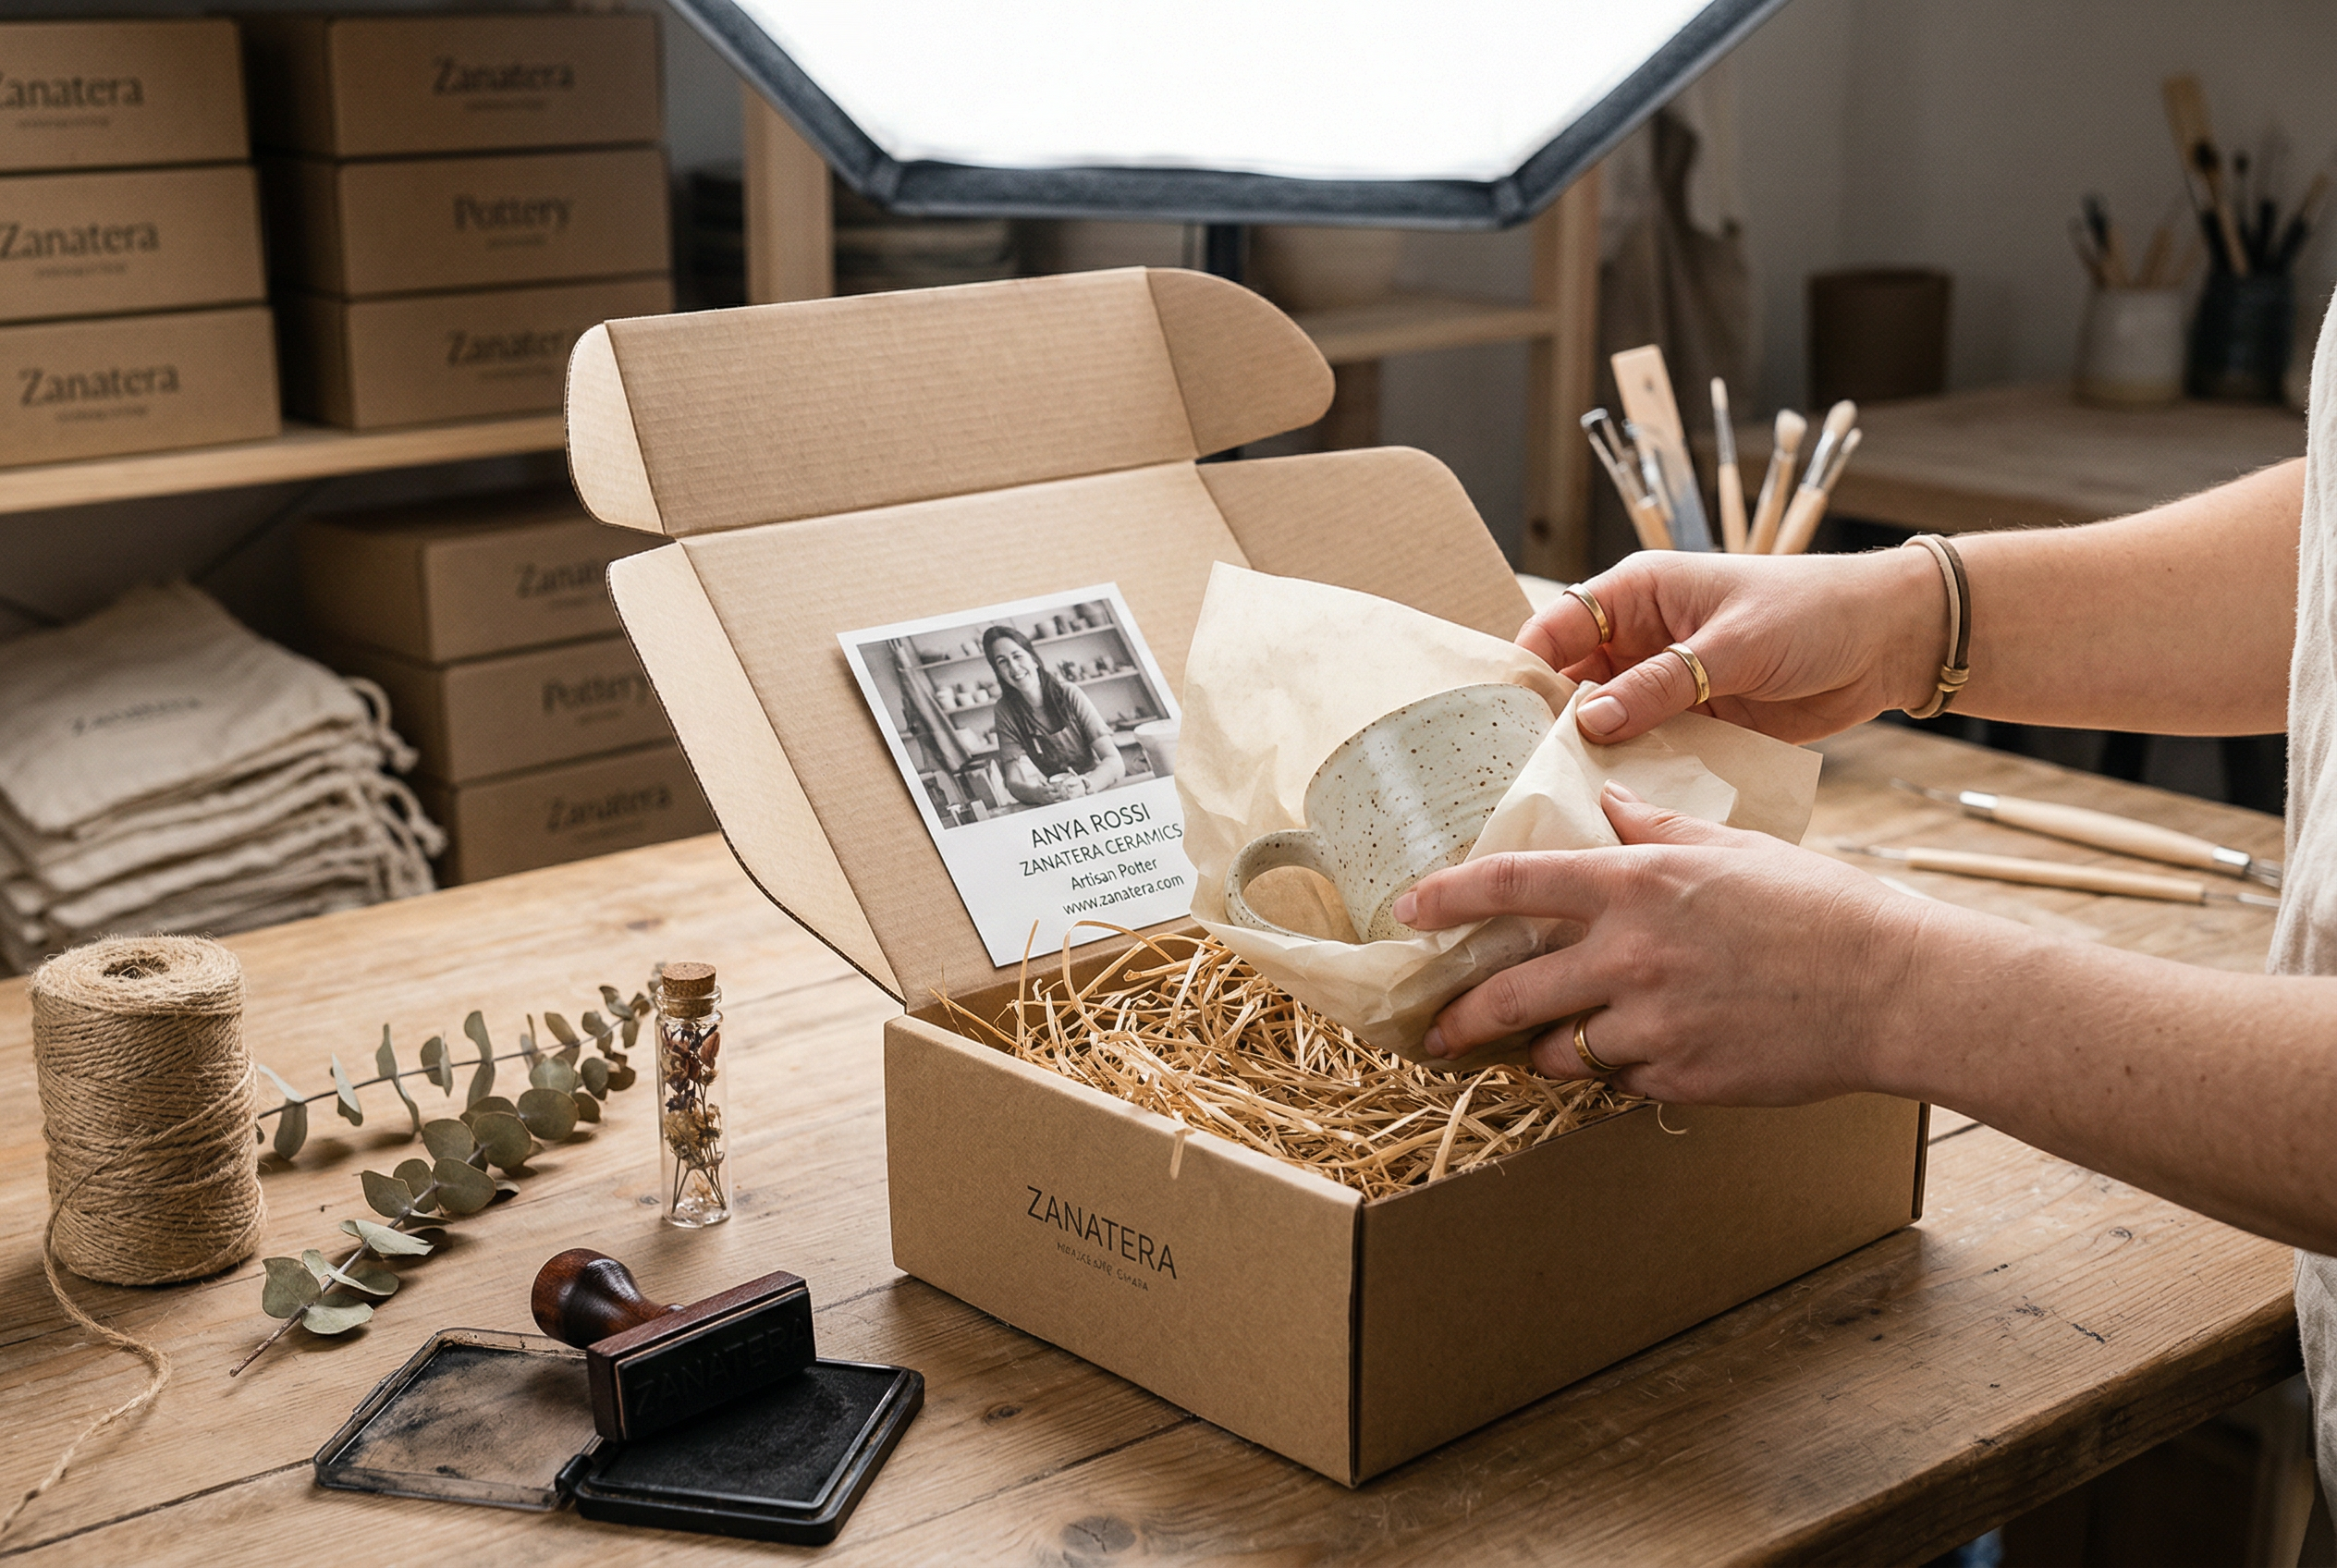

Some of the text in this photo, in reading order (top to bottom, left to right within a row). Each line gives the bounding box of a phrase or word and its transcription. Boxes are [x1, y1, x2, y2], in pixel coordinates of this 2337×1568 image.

[0, 72, 144, 109] anatera
[452, 193, 572, 233] Pottery
[18, 364, 181, 408] Zanatera
[1031, 802, 1151, 849] ANYA ROSSI
[1019, 823, 1183, 877] ZANATERA CERAMICS
[1062, 874, 1185, 915] www.zanatera.com
[1071, 858, 1158, 890] Artisan Potter
[1026, 1184, 1178, 1280] ZANATERA
